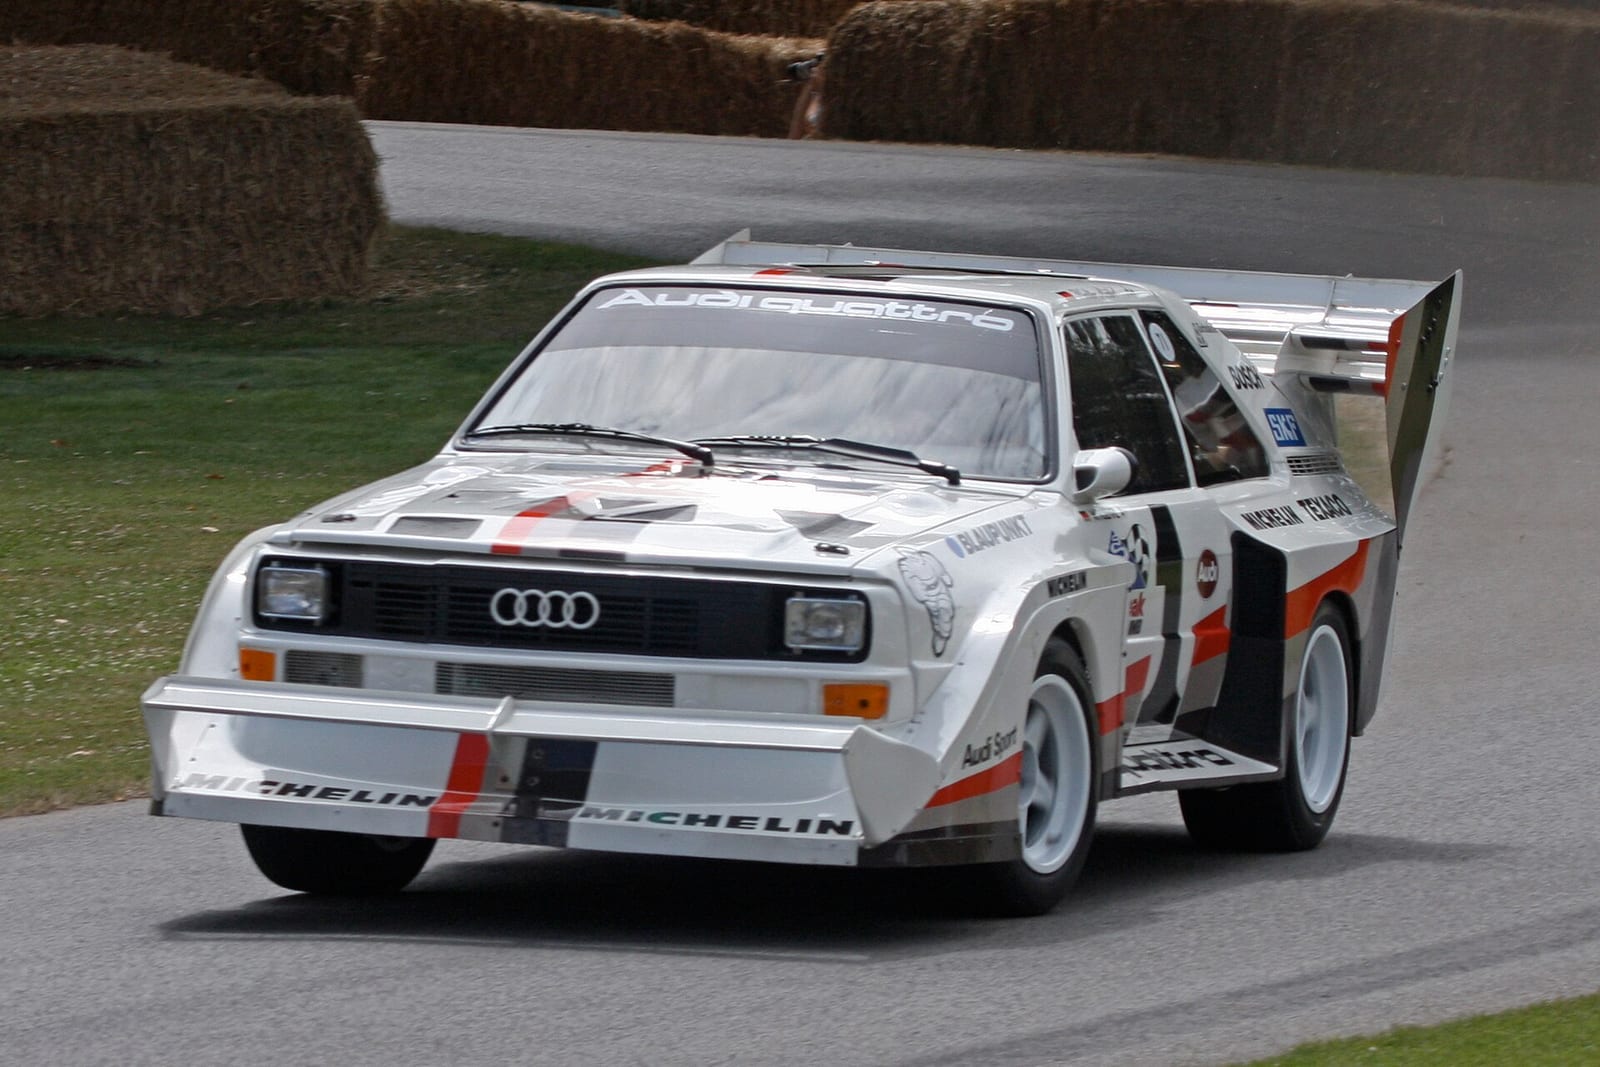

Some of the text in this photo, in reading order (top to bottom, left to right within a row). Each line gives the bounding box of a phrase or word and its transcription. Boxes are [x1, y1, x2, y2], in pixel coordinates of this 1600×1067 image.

[597, 288, 1015, 333] Audi quattro
[1227, 365, 1265, 390] BOSCH
[1266, 413, 1301, 442] SKF
[1240, 493, 1353, 531] MICHELIN TEXACO
[957, 514, 1033, 555] BLAUPUNKT
[1047, 571, 1087, 598] MICHELIN
[961, 726, 1018, 770] Audi Sport
[183, 773, 439, 807] MICHELIN
[577, 806, 857, 836] MICHELIN
